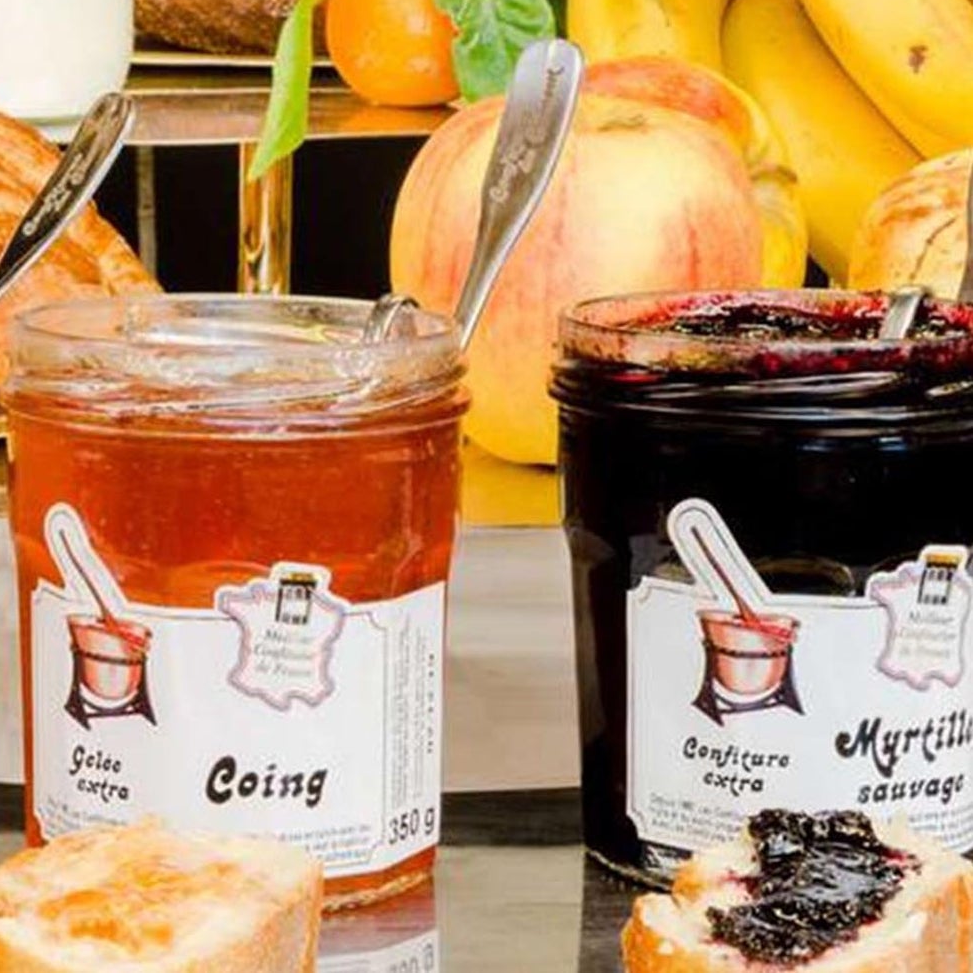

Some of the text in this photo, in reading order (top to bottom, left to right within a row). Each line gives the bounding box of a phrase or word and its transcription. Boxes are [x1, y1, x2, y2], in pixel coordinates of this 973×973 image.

[682, 736, 791, 773] Confiture
[76, 777, 130, 804] extra
[204, 755, 328, 809] Coing
[702, 769, 765, 798] extra
[856, 773, 965, 806] sauvage
[388, 807, 420, 845] 350
[423, 807, 435, 836] g
